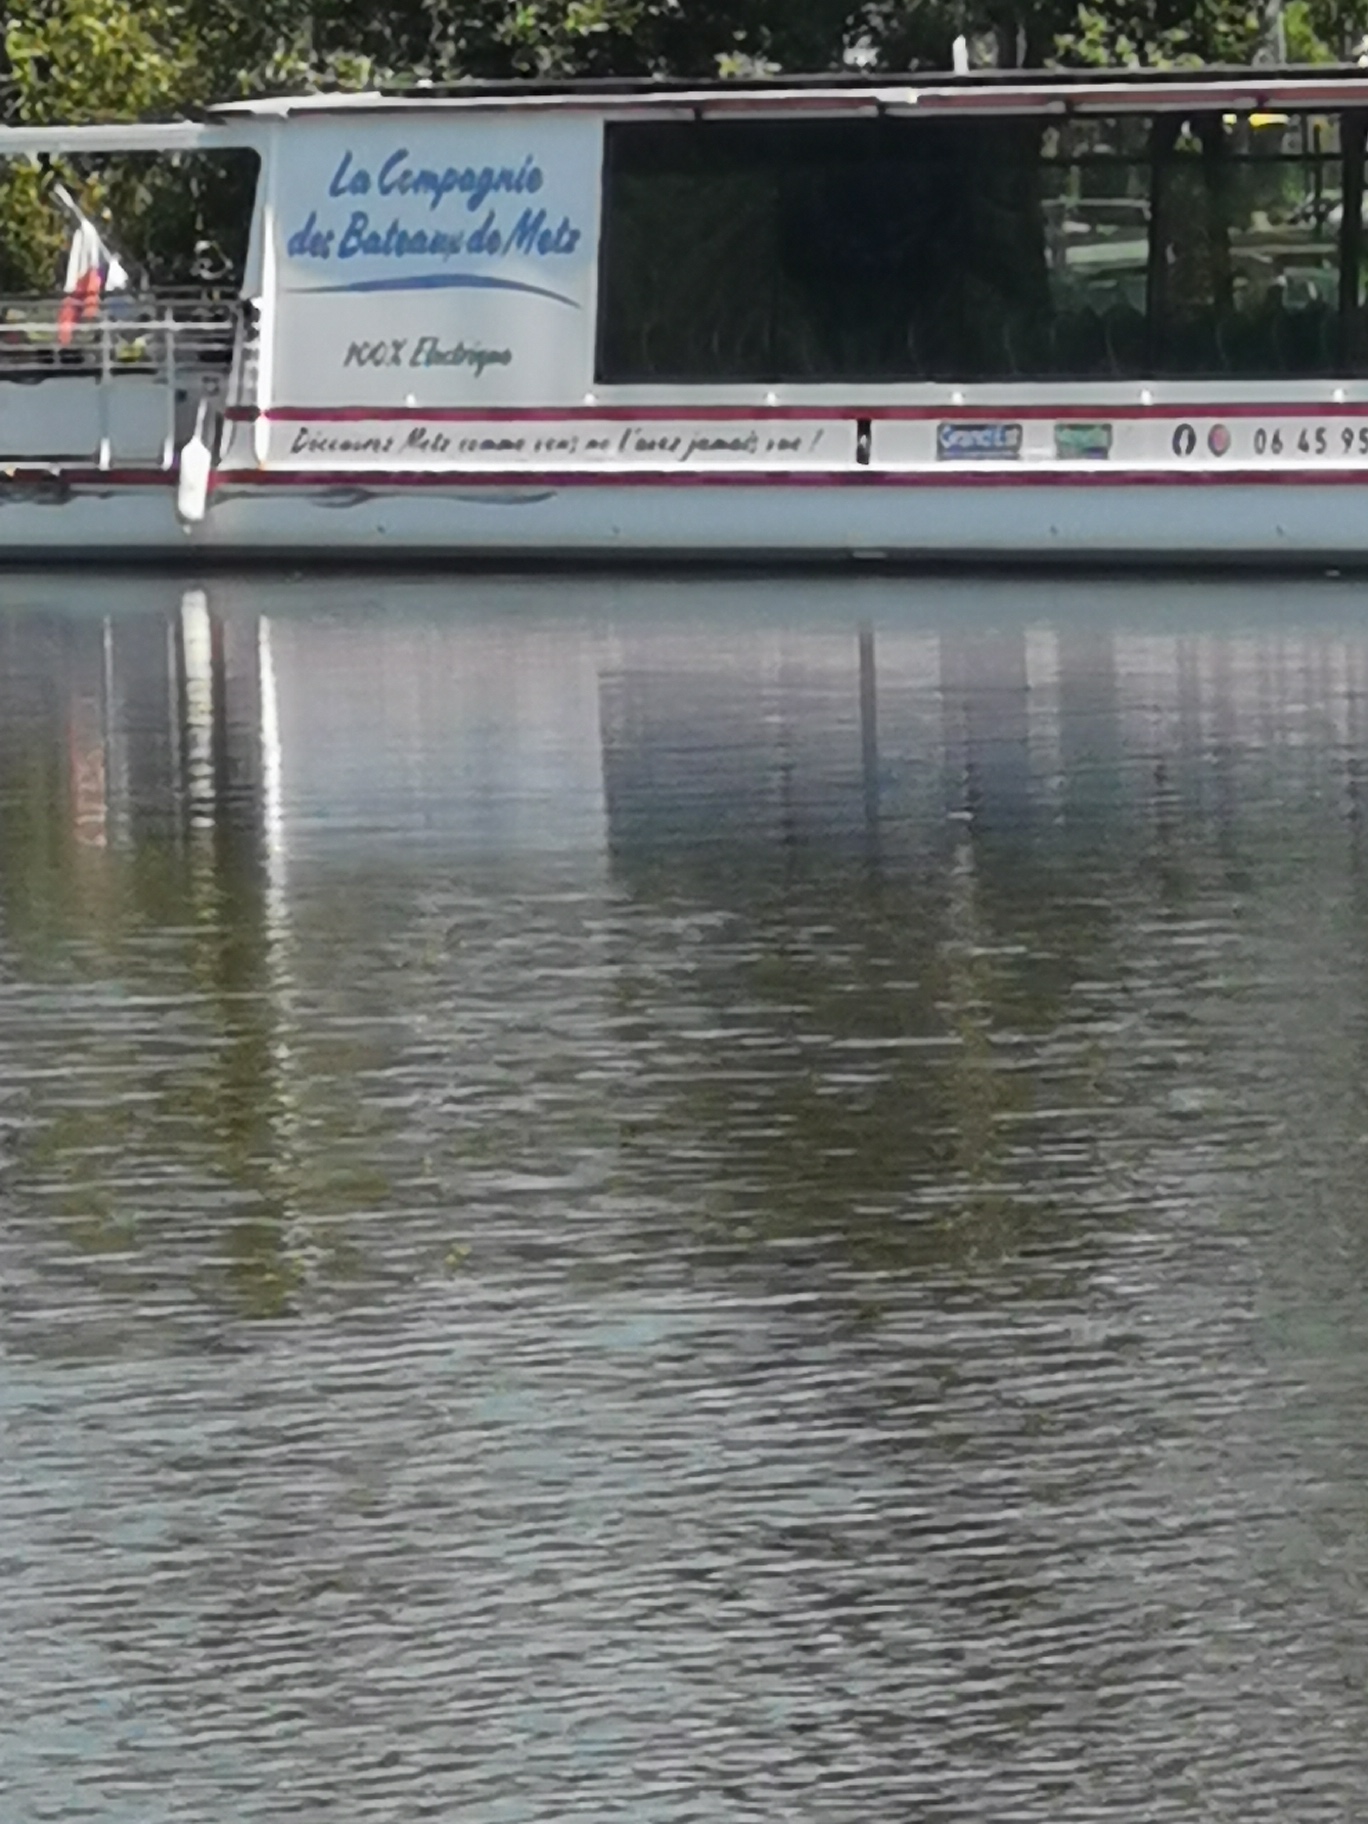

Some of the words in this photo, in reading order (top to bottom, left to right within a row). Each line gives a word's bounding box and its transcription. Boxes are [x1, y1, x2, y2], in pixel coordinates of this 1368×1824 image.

[328, 149, 371, 197] La
[377, 147, 543, 212] Compagnie
[287, 210, 335, 259] des
[337, 210, 464, 262] Bateaux
[466, 209, 501, 255] de
[502, 207, 581, 257] Metz
[343, 339, 407, 368] 100%
[1253, 427, 1284, 455] 06
[1297, 427, 1328, 455] 45
